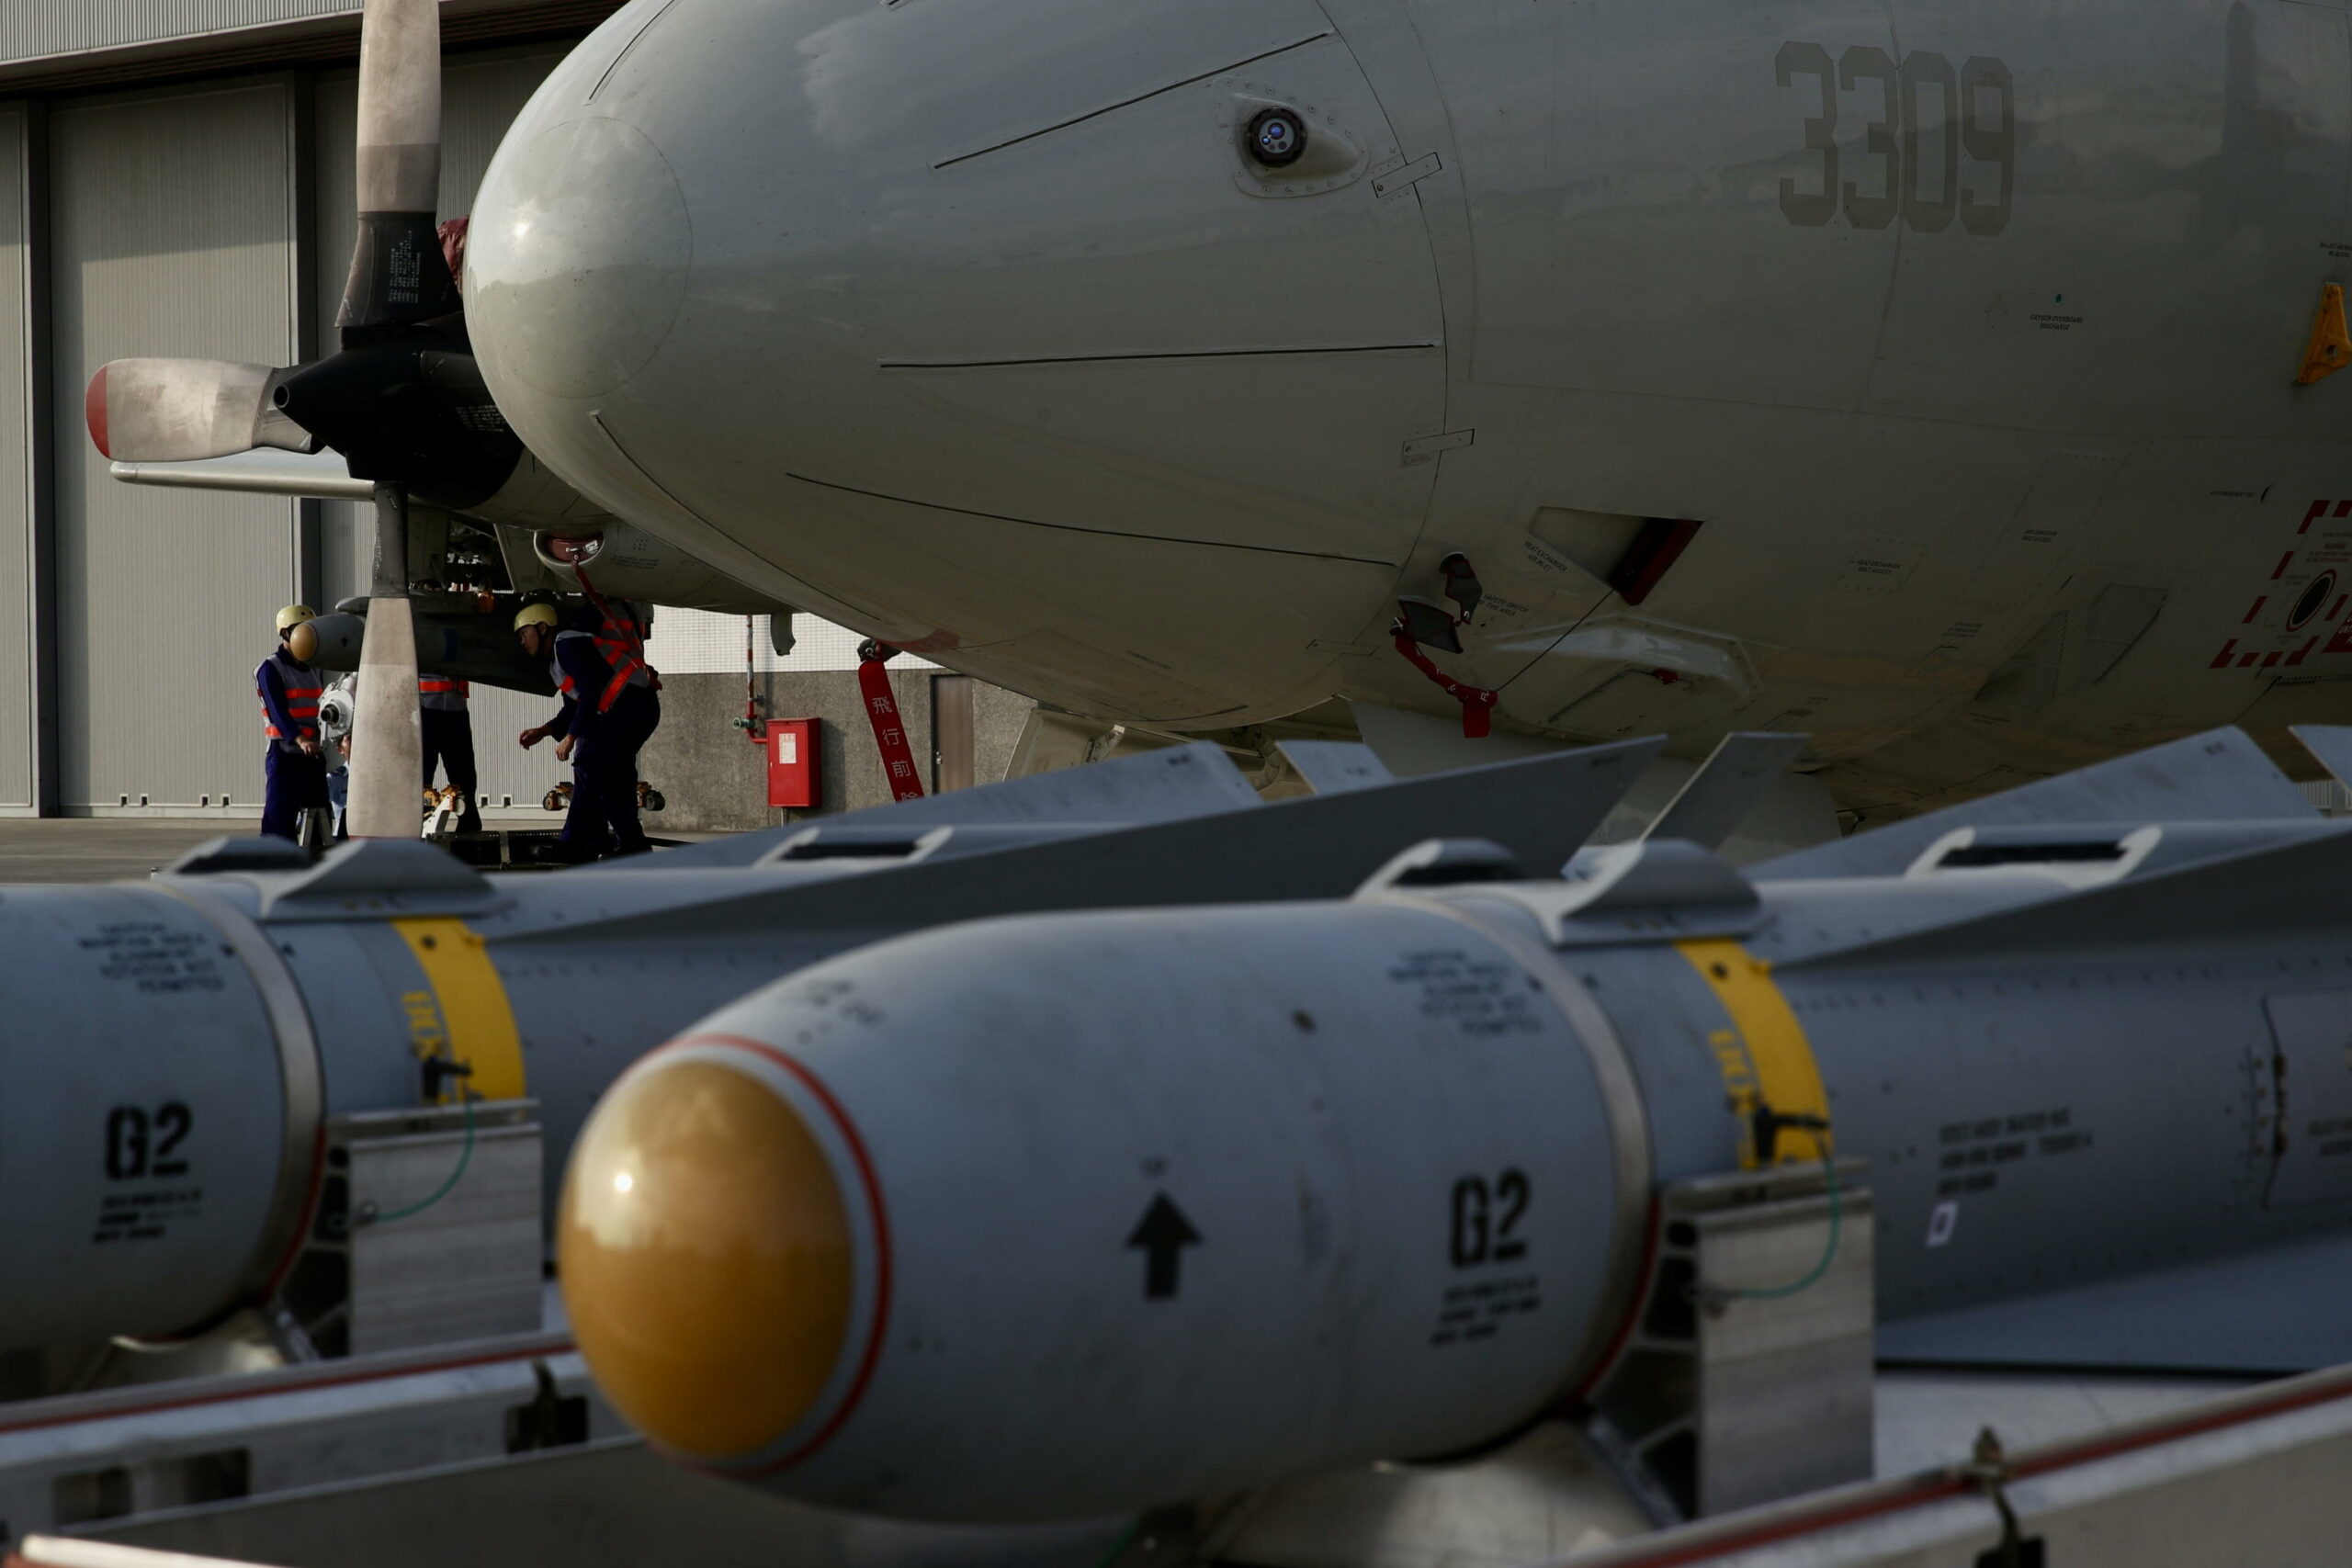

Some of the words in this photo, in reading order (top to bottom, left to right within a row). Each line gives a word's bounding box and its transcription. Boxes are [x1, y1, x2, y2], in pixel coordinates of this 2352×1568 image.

[1775, 40, 2016, 236] 3309
[1523, 540, 1537, 552] HEAT
[1537, 548, 1568, 572] EXCHANGER
[106, 1100, 193, 1180] G2
[1450, 1168, 1532, 1269] G2
